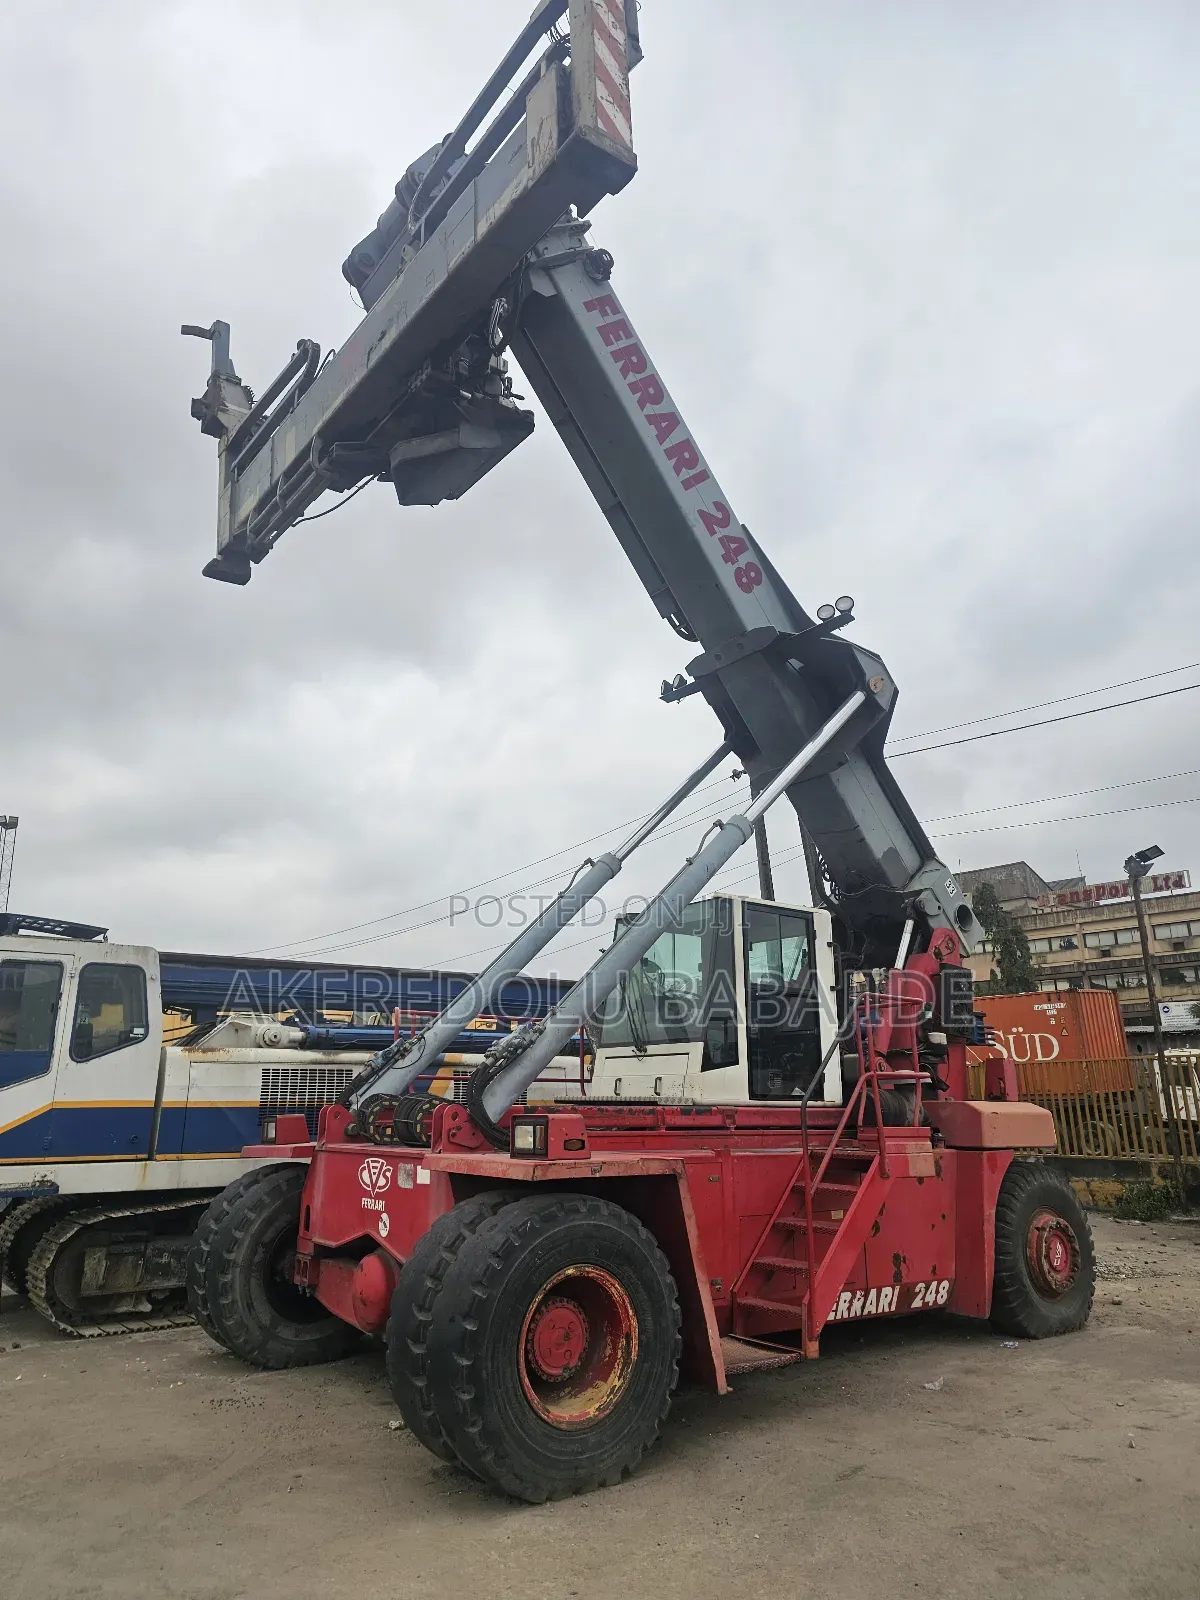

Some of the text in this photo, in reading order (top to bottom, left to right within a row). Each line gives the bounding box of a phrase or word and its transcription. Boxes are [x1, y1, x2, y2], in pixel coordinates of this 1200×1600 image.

[583, 293, 764, 595] FERRARI 248
[1151, 874, 1186, 892] Ltd
[987, 1027, 1060, 1062] SÜD
[361, 1197, 386, 1212] FERRARI
[826, 1279, 950, 1321] ERRARI 248
